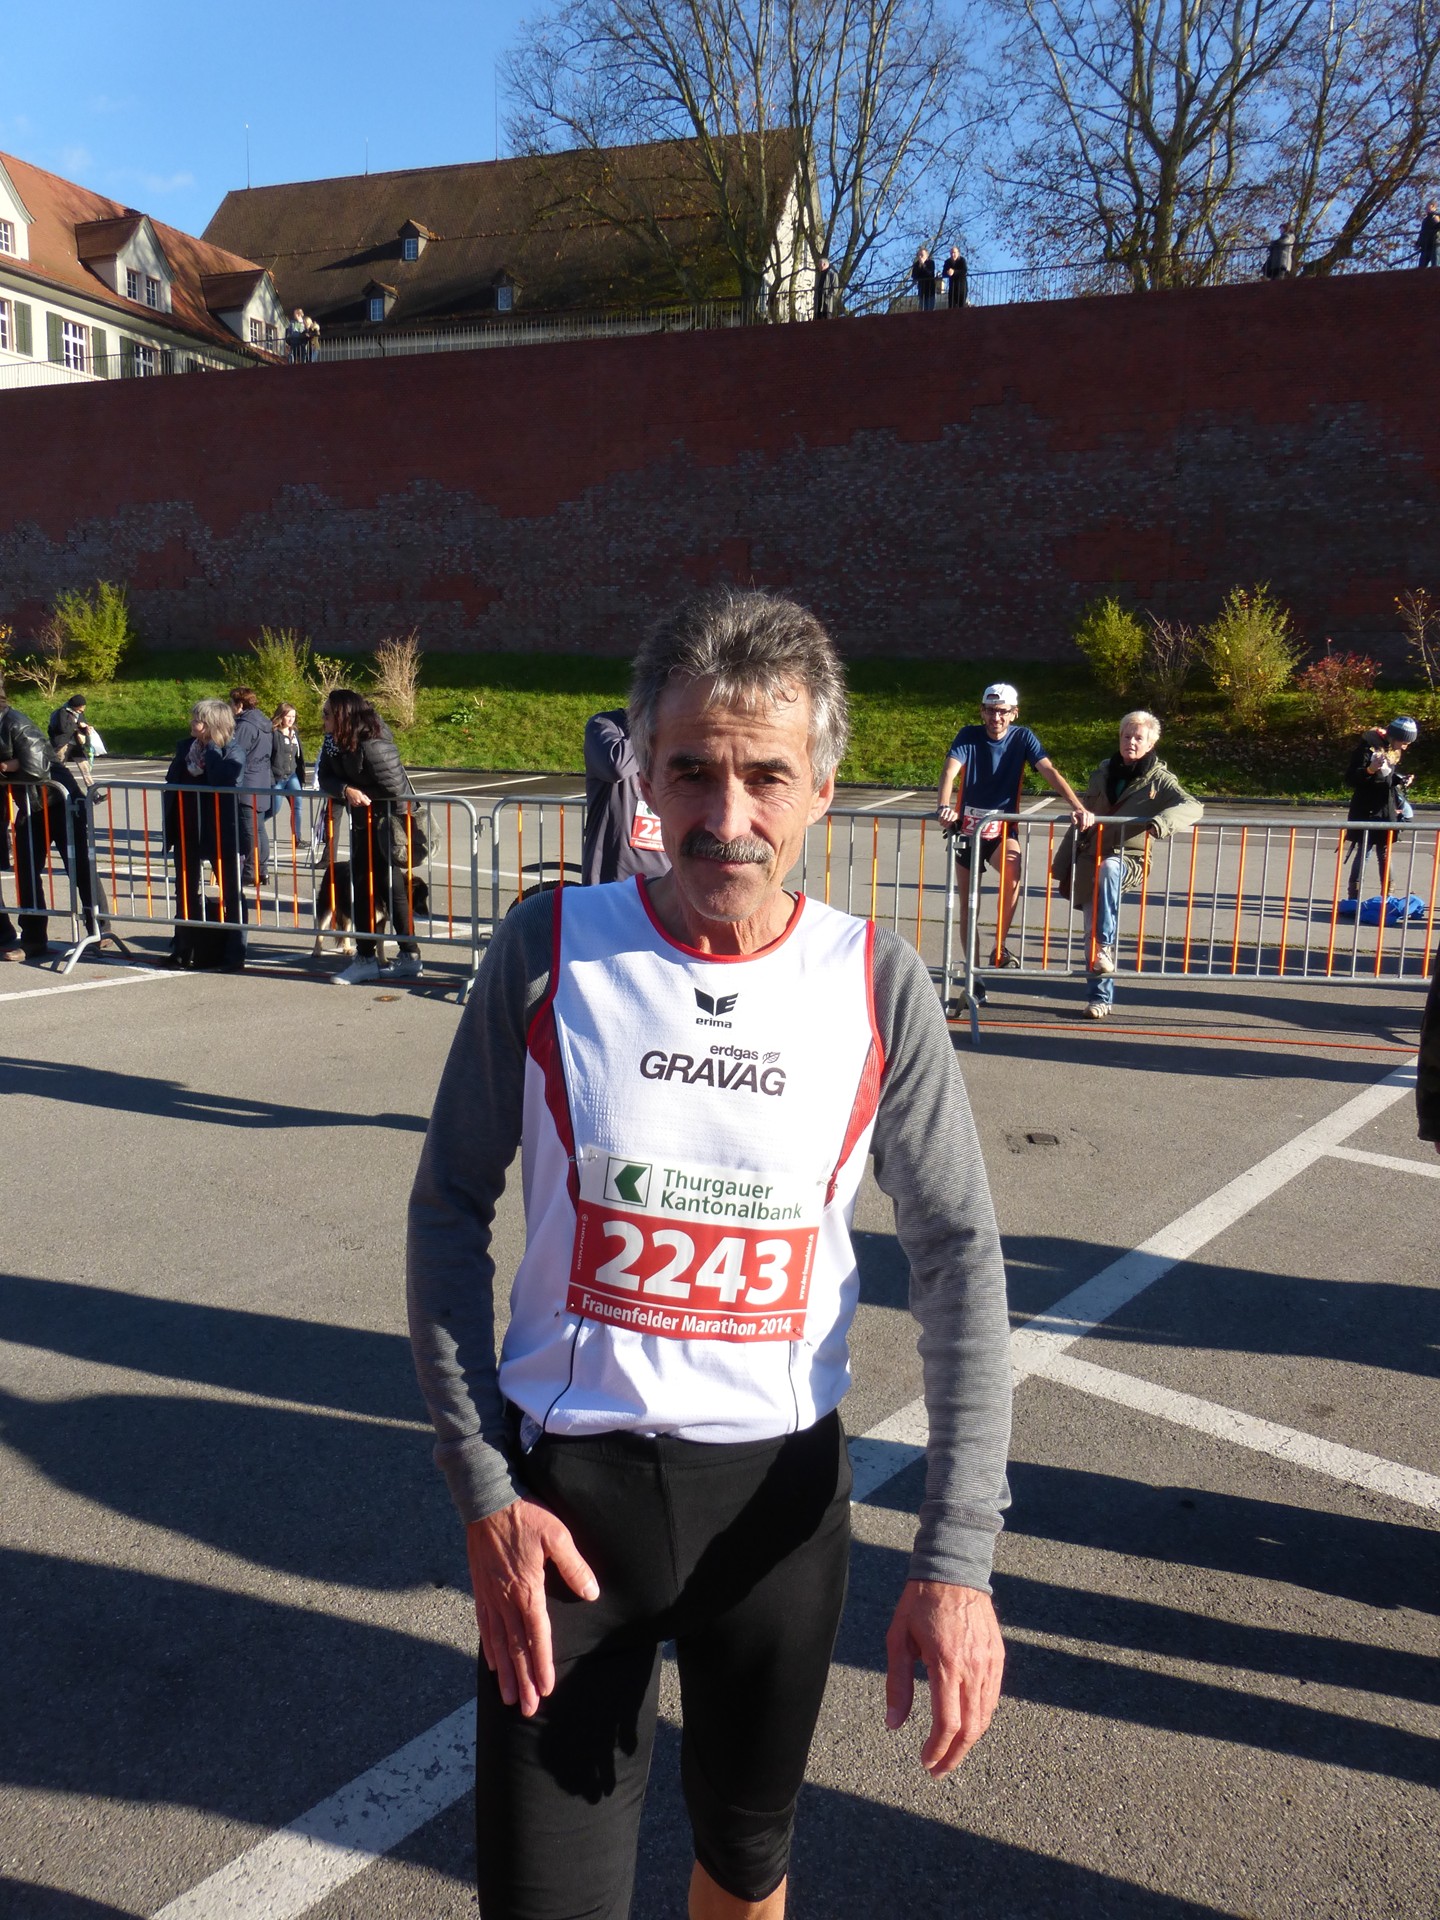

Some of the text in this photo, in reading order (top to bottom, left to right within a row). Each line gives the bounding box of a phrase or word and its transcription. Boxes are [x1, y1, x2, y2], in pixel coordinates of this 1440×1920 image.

[696, 1017, 733, 1029] erima
[709, 1044, 759, 1061] erdgas
[639, 1050, 787, 1097] GRAVAG
[663, 1168, 774, 1199] Thurgauer
[660, 1190, 803, 1220] Kantonalbank
[594, 1220, 792, 1306] 2243
[582, 1293, 792, 1336] Frauenfelder Marathon 2014
